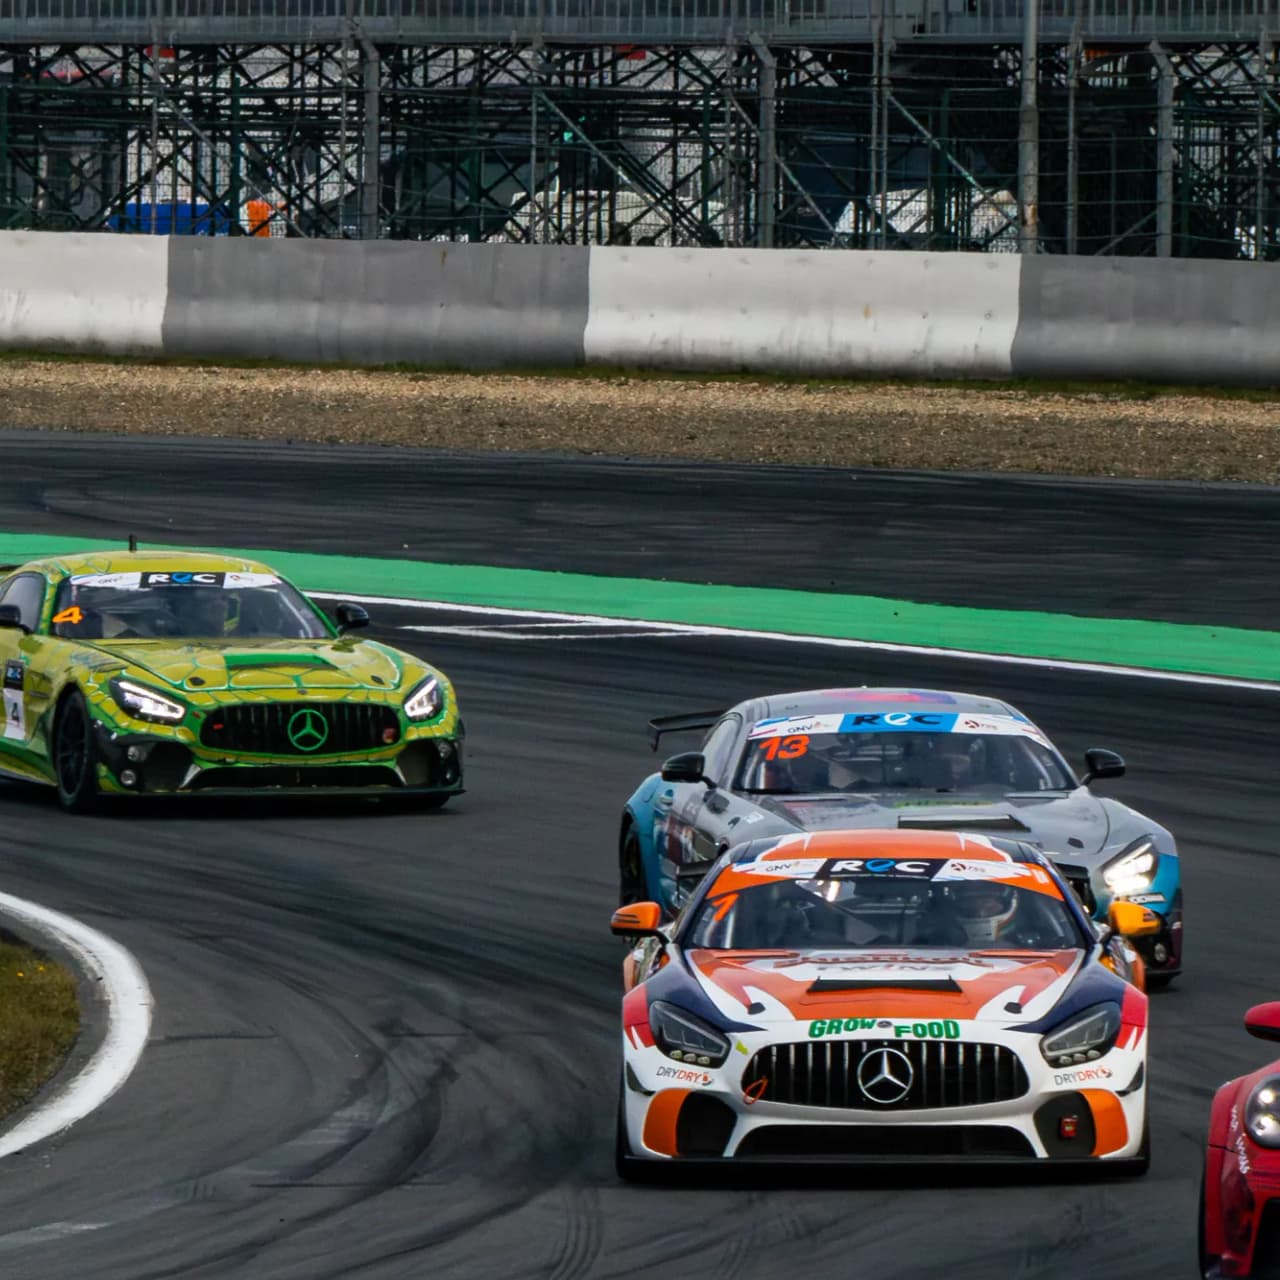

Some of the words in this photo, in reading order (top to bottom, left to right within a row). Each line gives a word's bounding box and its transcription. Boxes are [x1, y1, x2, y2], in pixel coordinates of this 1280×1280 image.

[52, 606, 84, 624] 4
[11, 702, 20, 722] 4
[759, 735, 810, 761] 13
[712, 894, 739, 921] 1
[808, 1019, 877, 1038] GROW
[895, 1020, 960, 1039] FOOD
